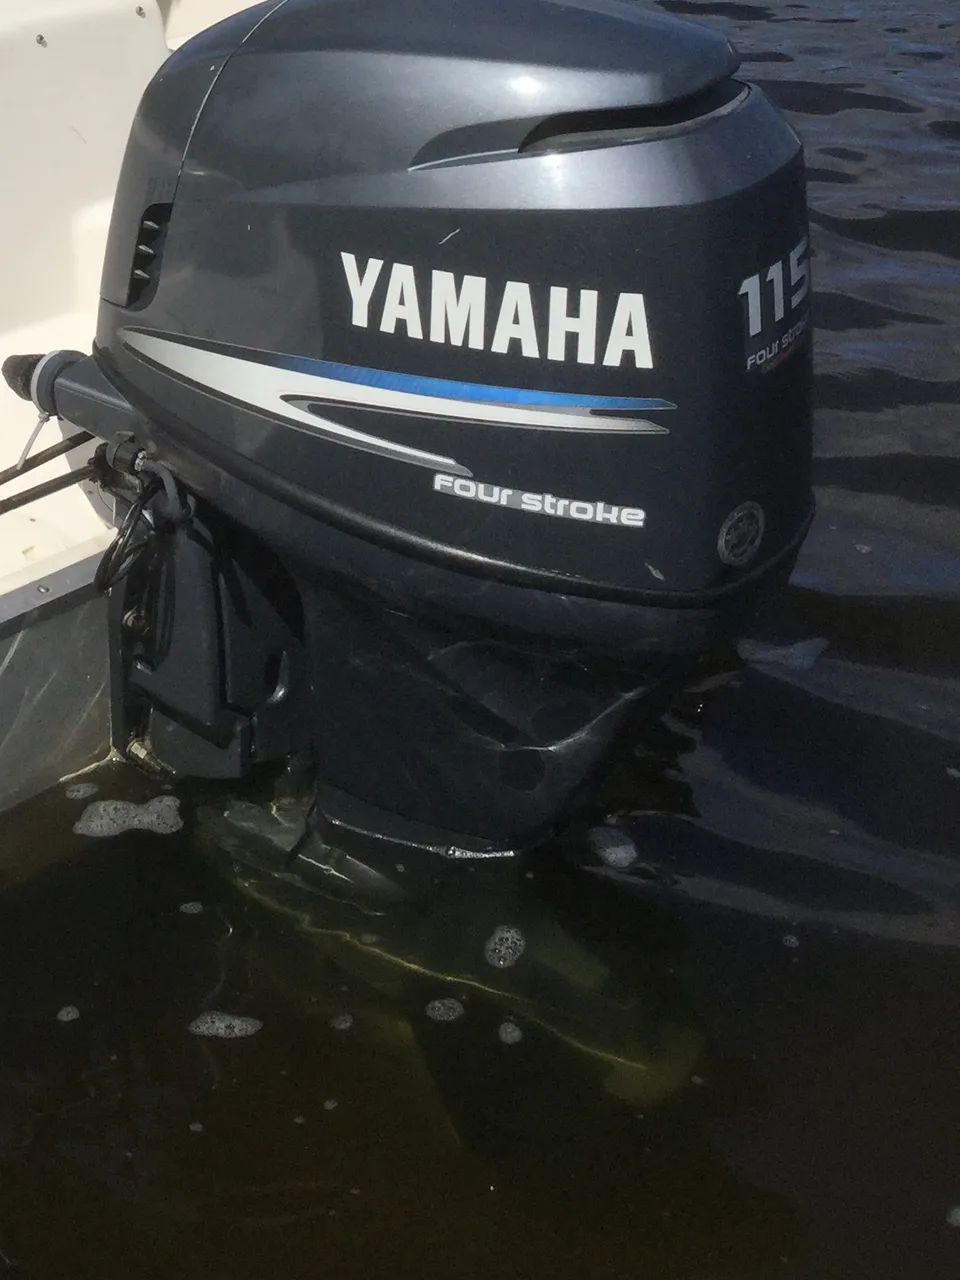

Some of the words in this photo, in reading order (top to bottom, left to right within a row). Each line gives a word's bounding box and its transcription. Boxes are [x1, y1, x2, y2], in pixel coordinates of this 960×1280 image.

[340, 251, 654, 369] YAMAHA
[737, 235, 810, 337] 115
[520, 492, 646, 528] stroke
